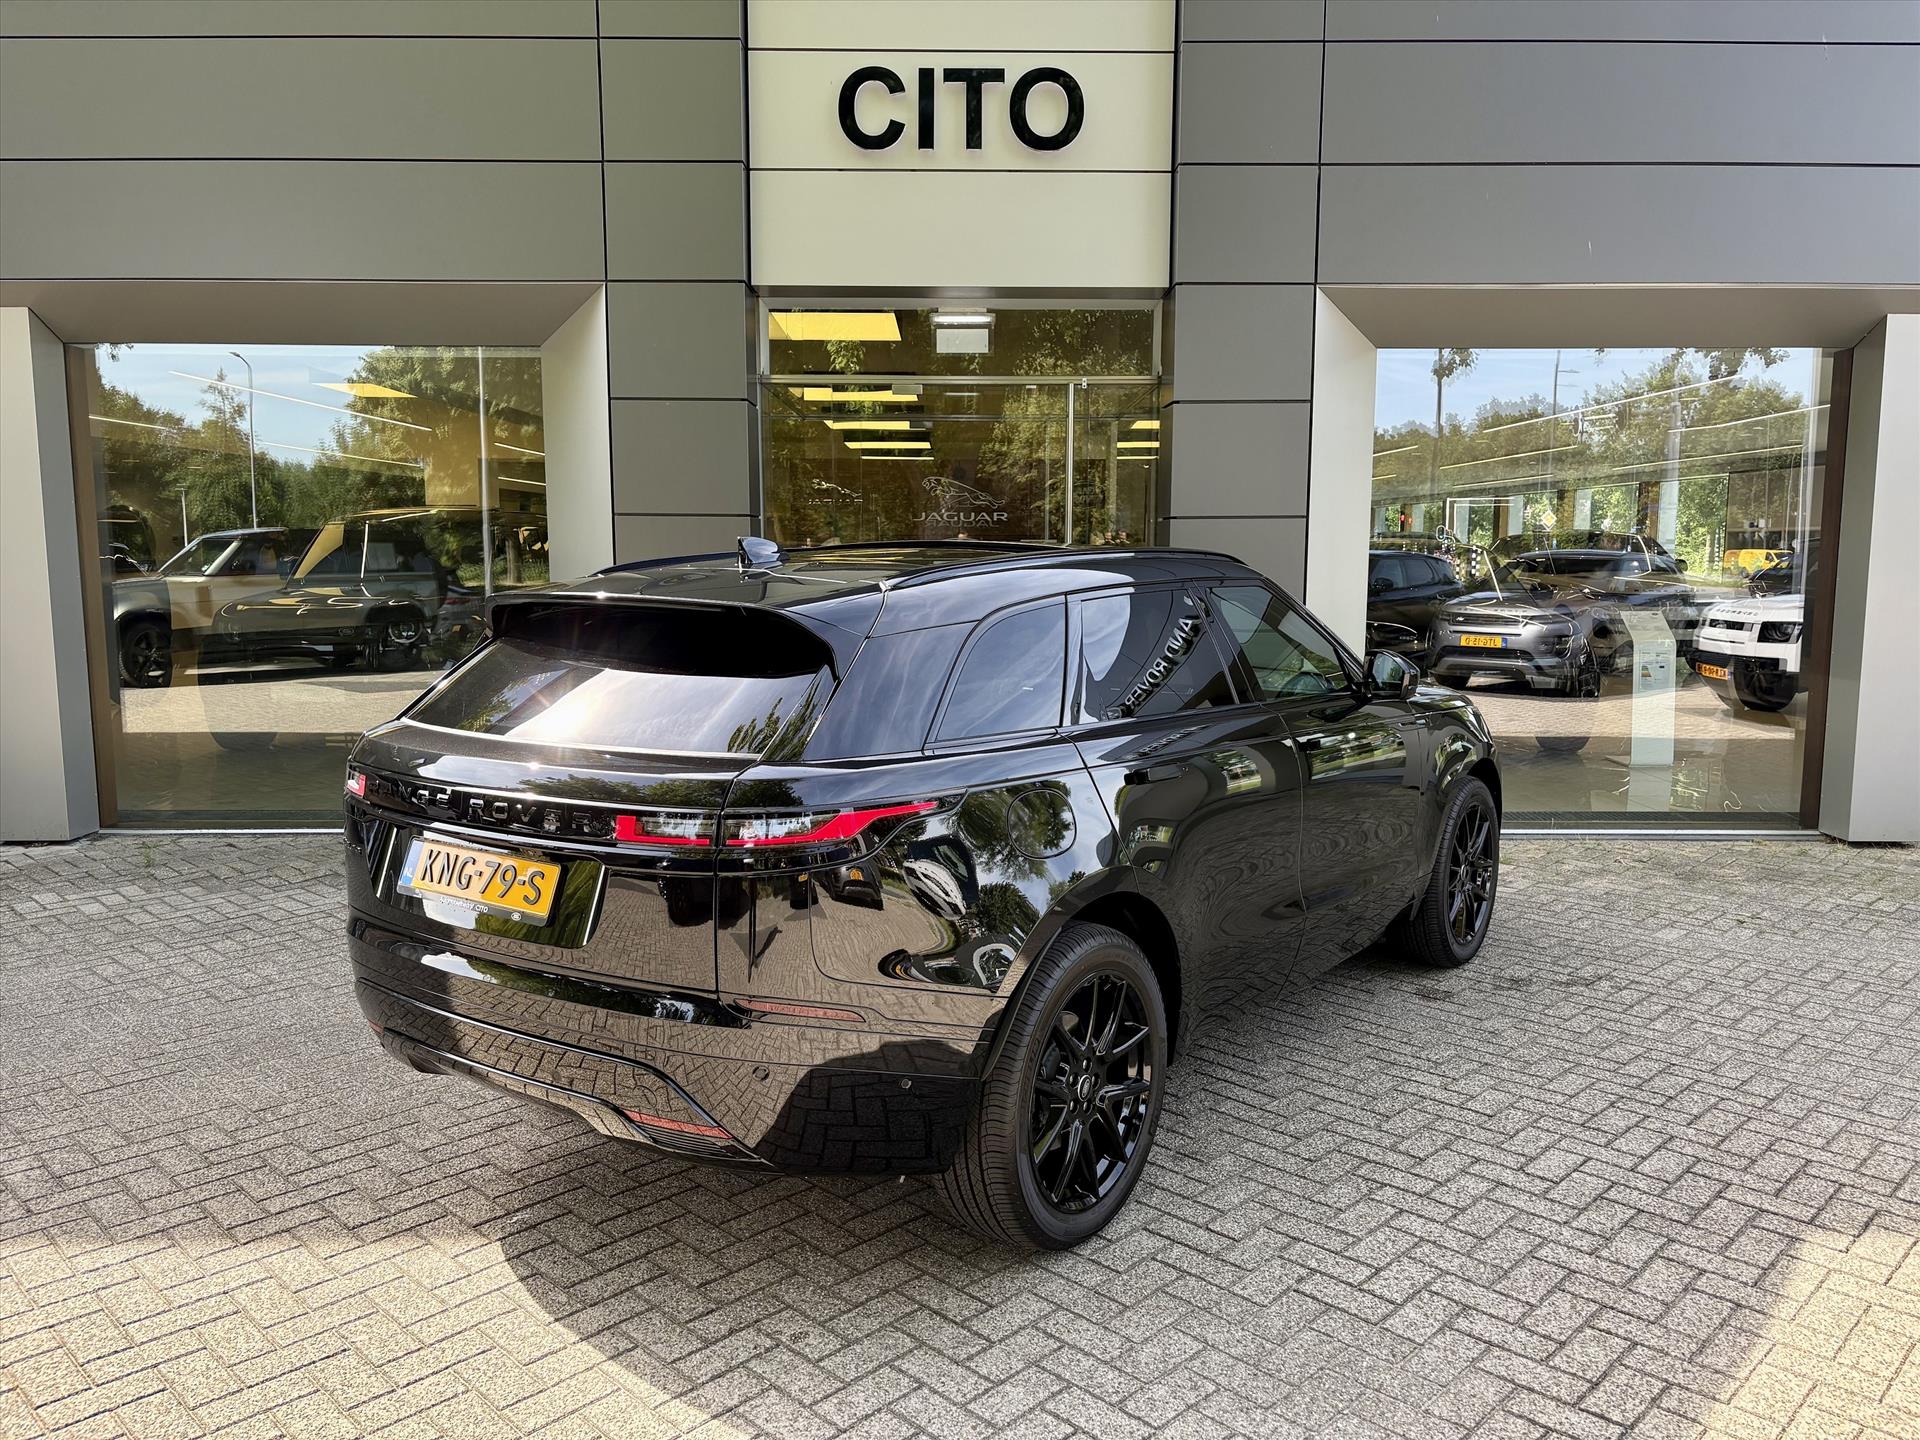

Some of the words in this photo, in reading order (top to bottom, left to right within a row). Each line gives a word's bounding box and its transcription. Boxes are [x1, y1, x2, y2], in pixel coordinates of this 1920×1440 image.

[838, 66, 1085, 151] CITO
[912, 512, 1008, 521] JAGUAR
[468, 798, 594, 834] ROVER
[420, 849, 546, 906] KNG-79-S
